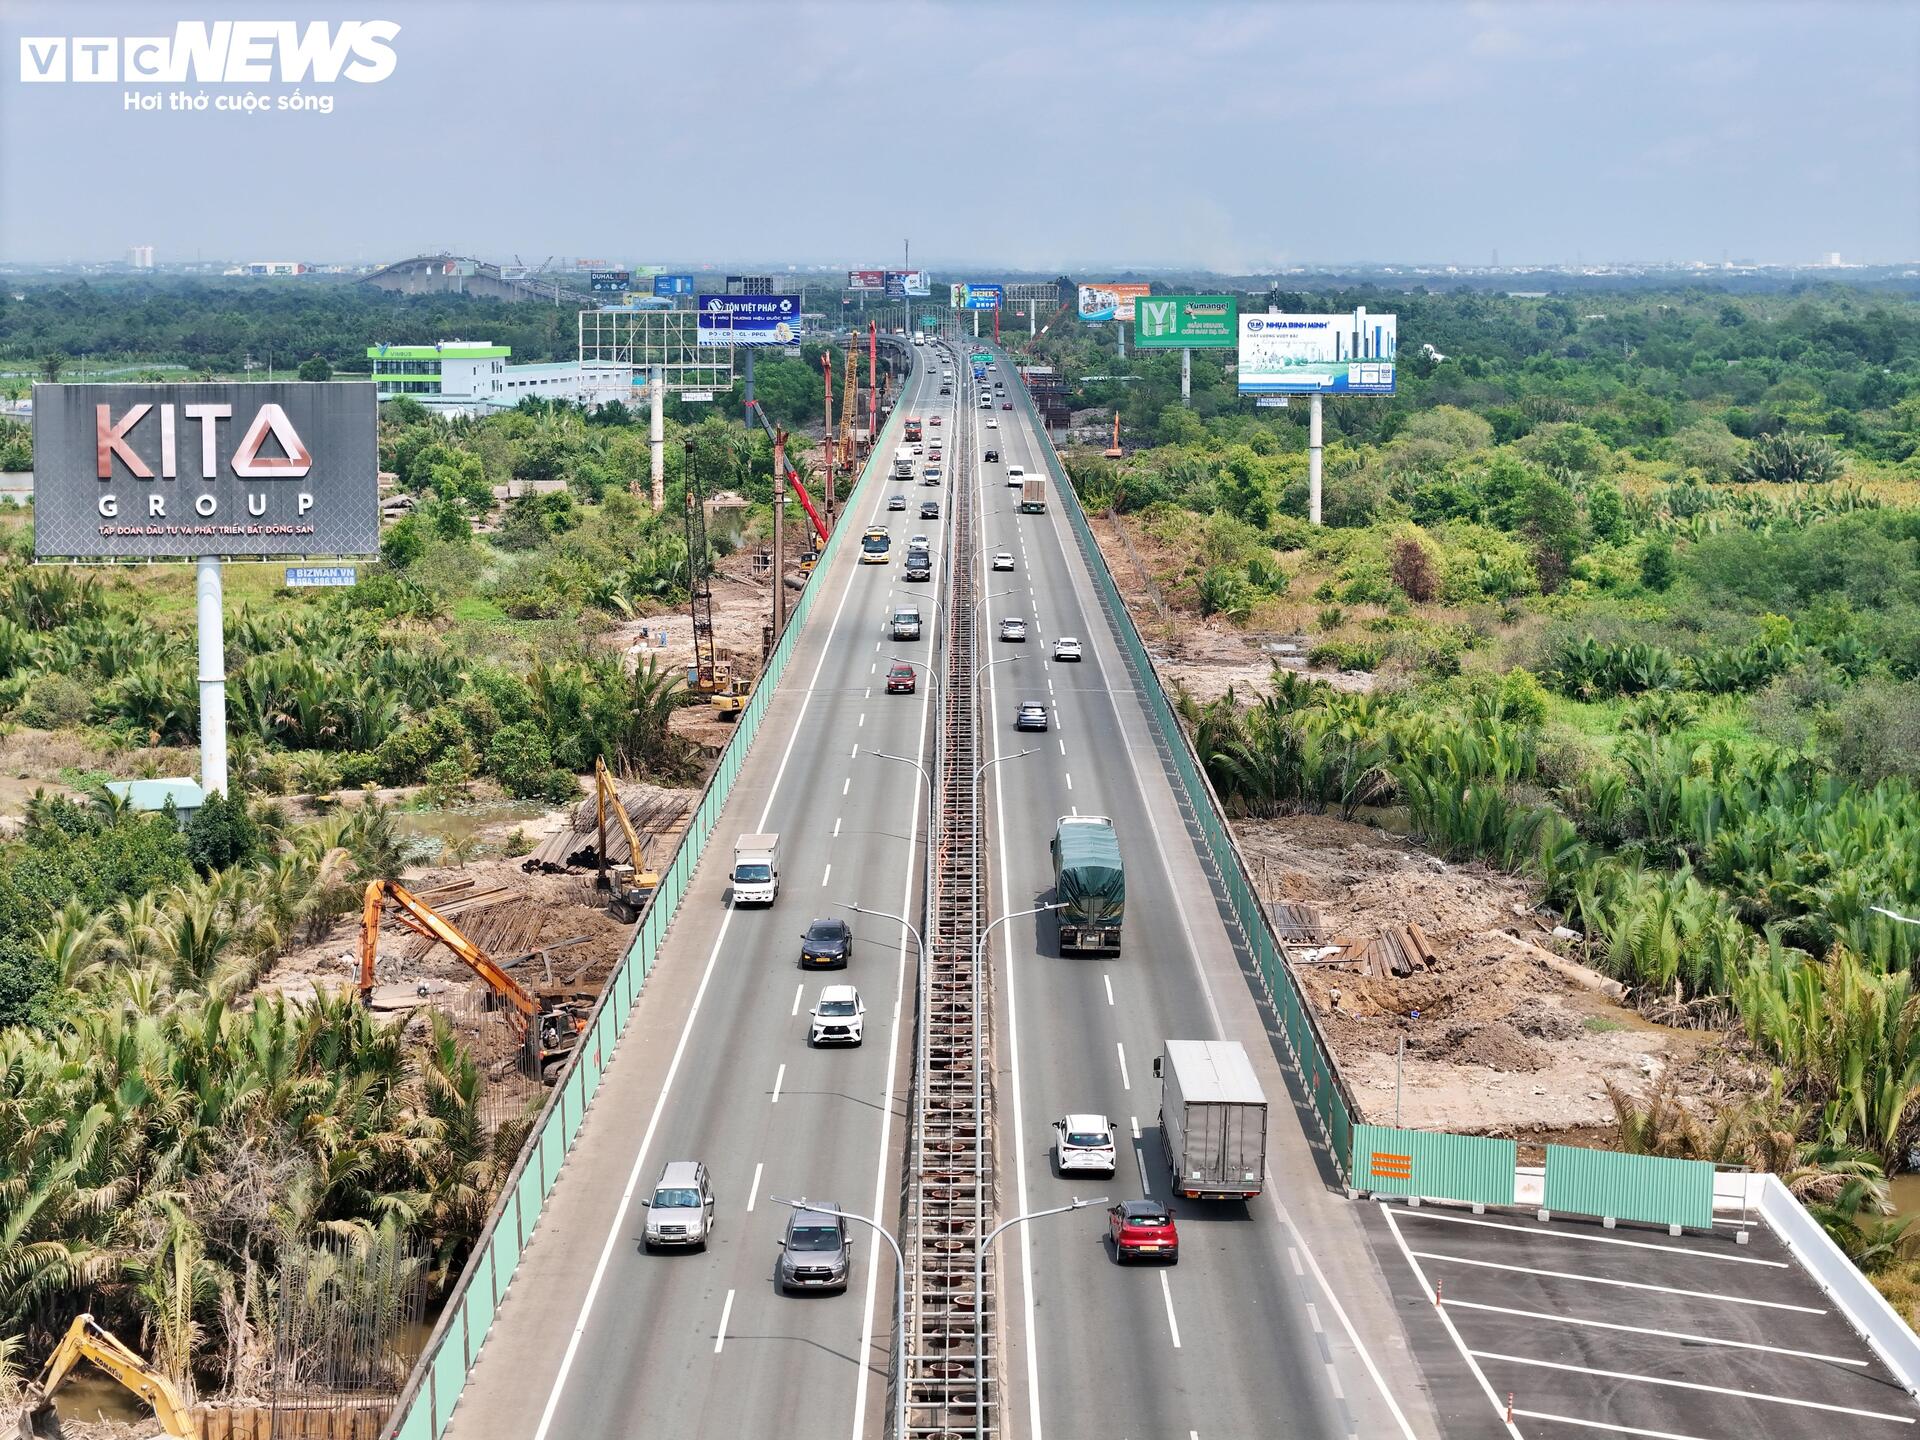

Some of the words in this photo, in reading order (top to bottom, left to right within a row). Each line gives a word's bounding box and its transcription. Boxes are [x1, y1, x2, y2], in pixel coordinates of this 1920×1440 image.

[725, 302, 741, 312] TÔN
[741, 302, 757, 314] VIỆT
[757, 302, 777, 312] PHÁP
[1188, 302, 1229, 311] Yumangel
[1266, 321, 1288, 330] NHỰA
[96, 403, 313, 479] KITA
[98, 493, 314, 518] GROUP
[296, 568, 354, 578] BIZMAN.VN
[94, 1355, 123, 1380] KOMATSU
